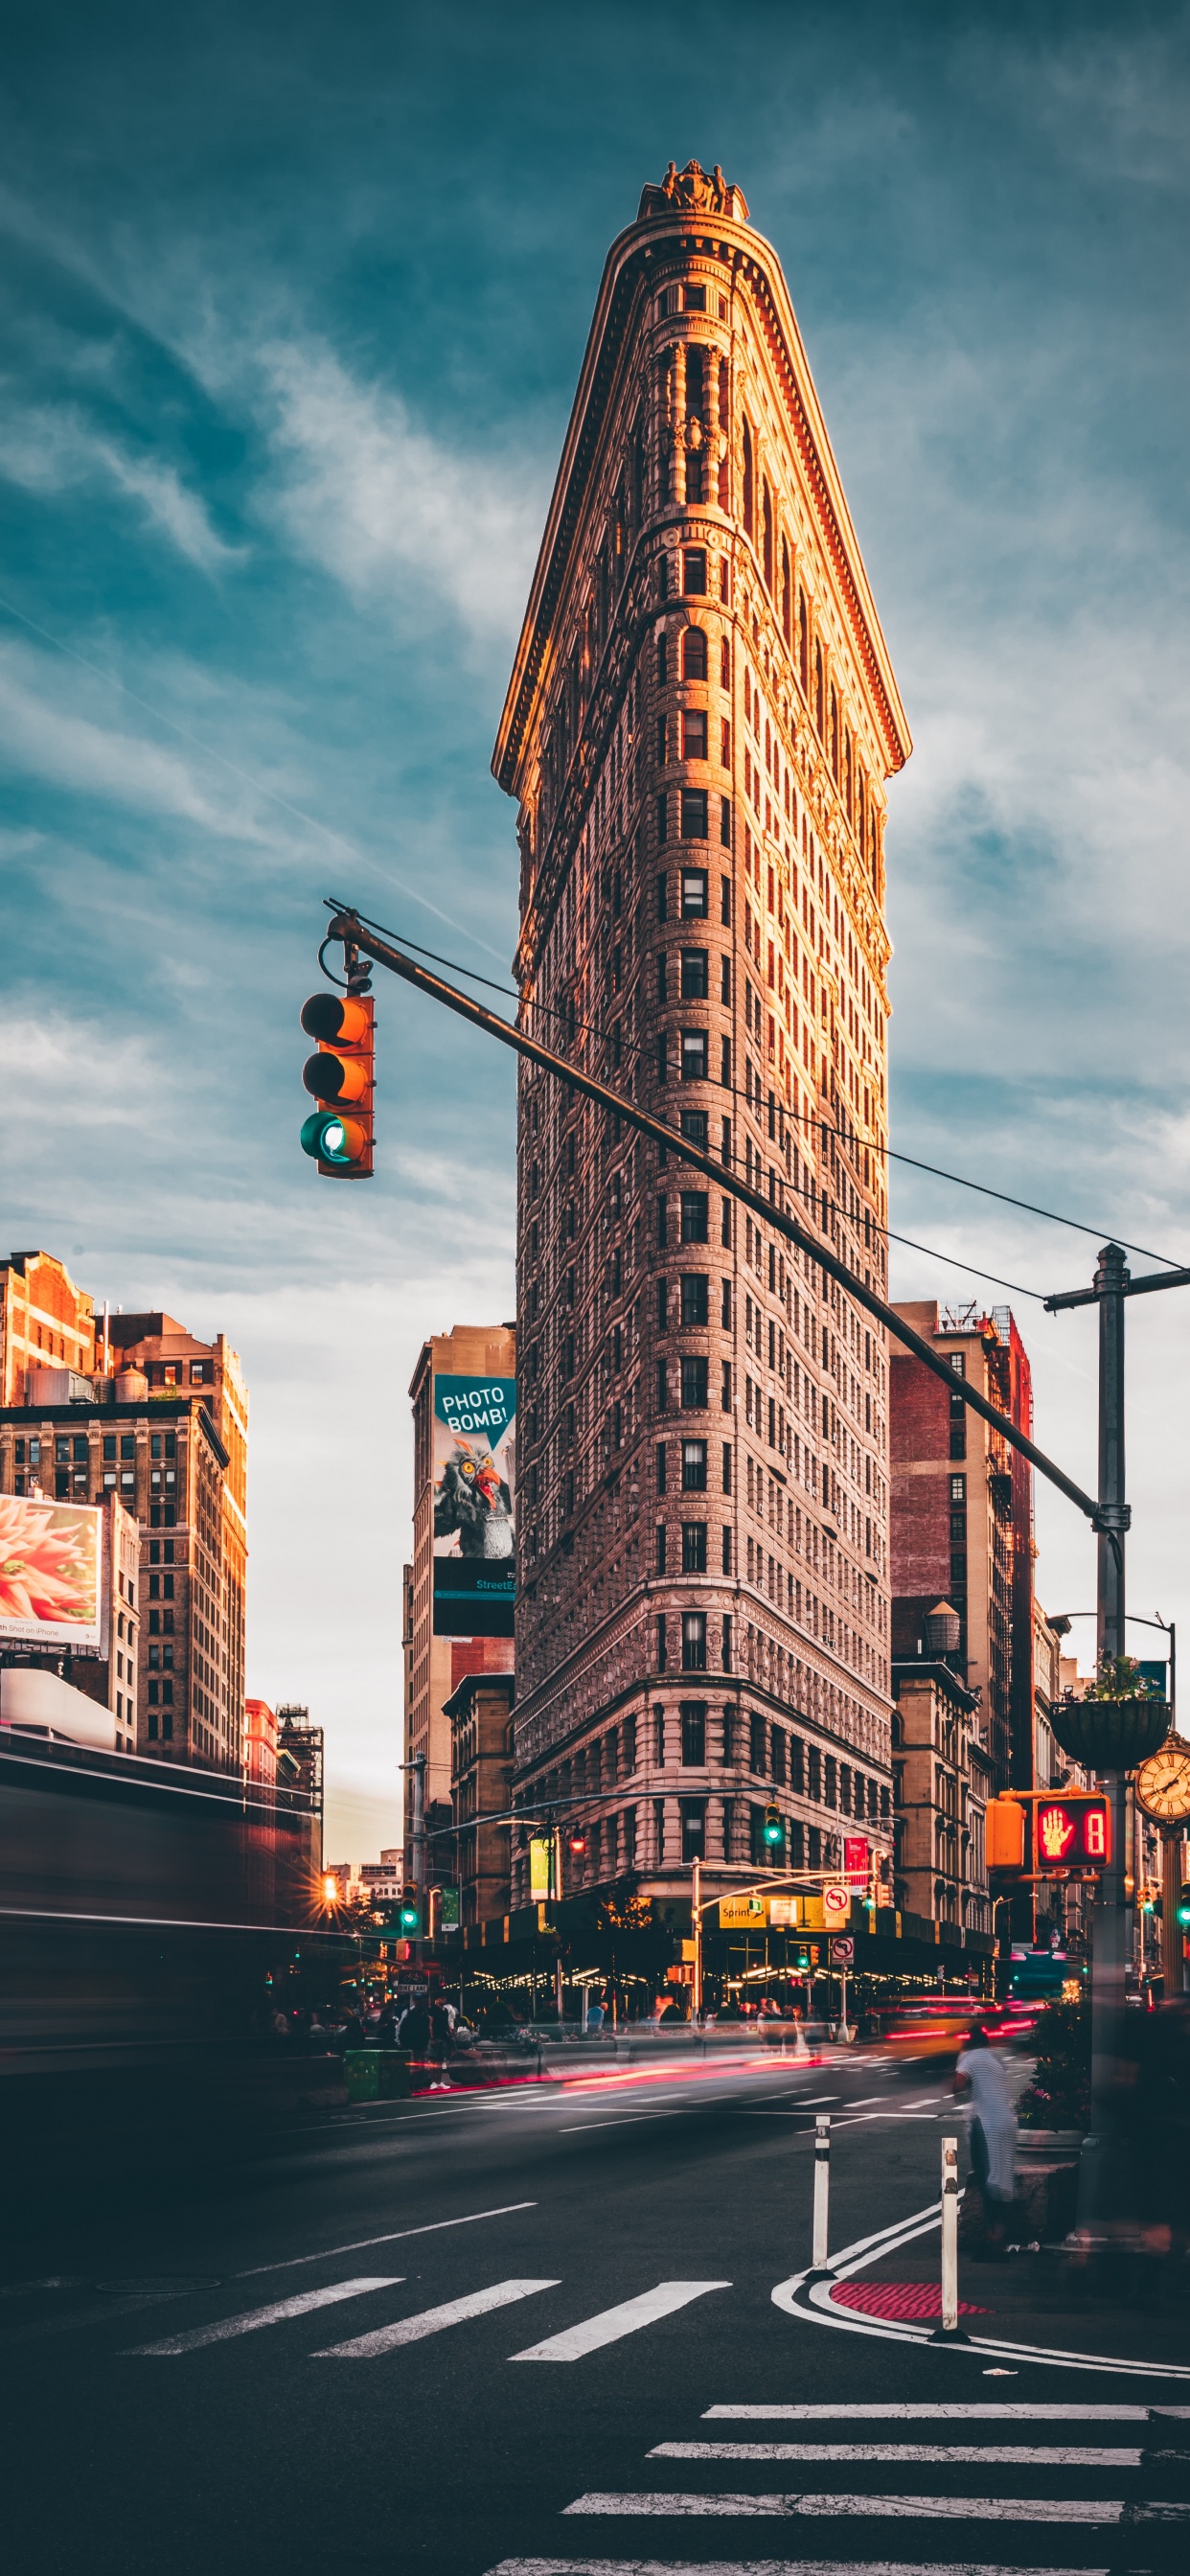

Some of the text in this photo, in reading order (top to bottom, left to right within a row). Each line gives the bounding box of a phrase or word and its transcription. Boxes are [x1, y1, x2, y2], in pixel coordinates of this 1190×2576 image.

[442, 1387, 504, 1414] PHOTO
[447, 1407, 508, 1434] BOMB!
[9, 1624, 25, 1633] Shot
[35, 1627, 59, 1637] iPhone
[723, 1908, 750, 1919] Sprint
